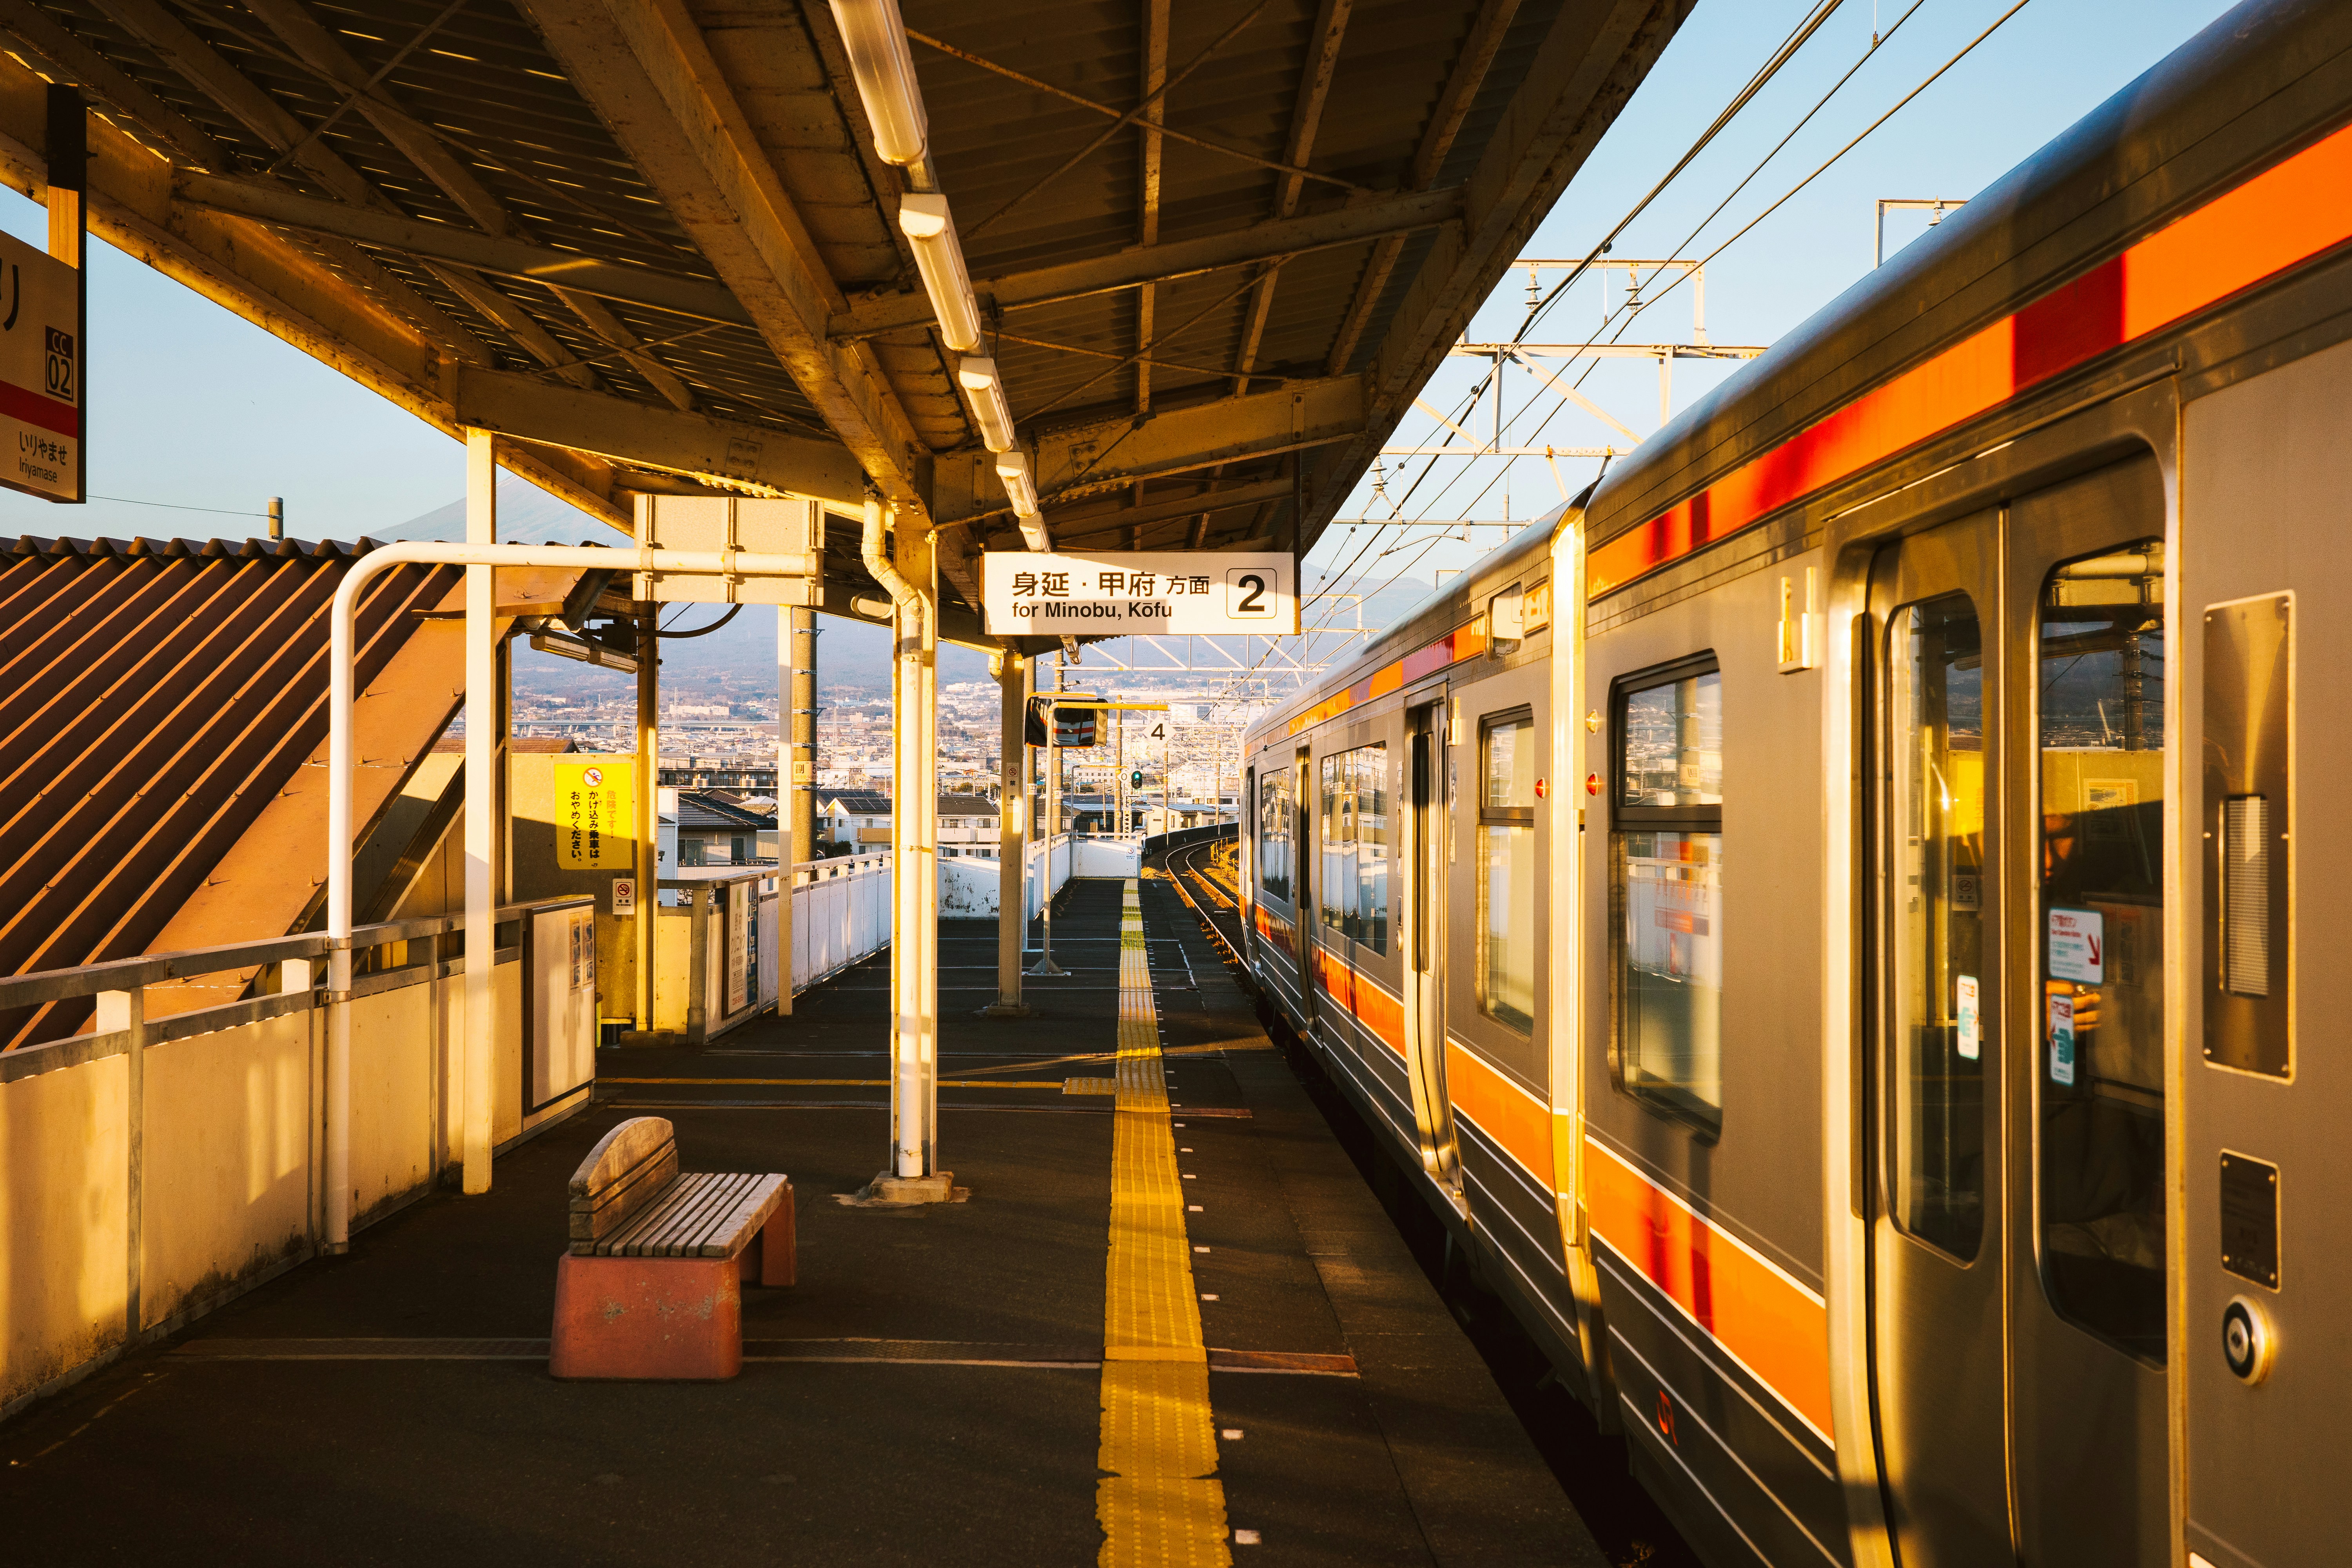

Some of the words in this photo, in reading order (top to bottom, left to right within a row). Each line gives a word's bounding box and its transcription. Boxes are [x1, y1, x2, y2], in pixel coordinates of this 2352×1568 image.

[53, 332, 66, 354] CC
[48, 354, 71, 395] 02
[20, 431, 67, 466] いりやませ
[20, 456, 57, 483] Iriyamase
[1166, 575, 1210, 595] 方面
[1238, 574, 1265, 612] 2
[1012, 602, 1038, 617] for
[1045, 602, 1122, 620] Minobu,
[1129, 602, 1172, 617] Kōfu
[1151, 723, 1165, 740] 4
[796, 764, 804, 773] 副
[571, 791, 582, 862] おやめください。
[589, 791, 600, 858] かけ込み乗車は
